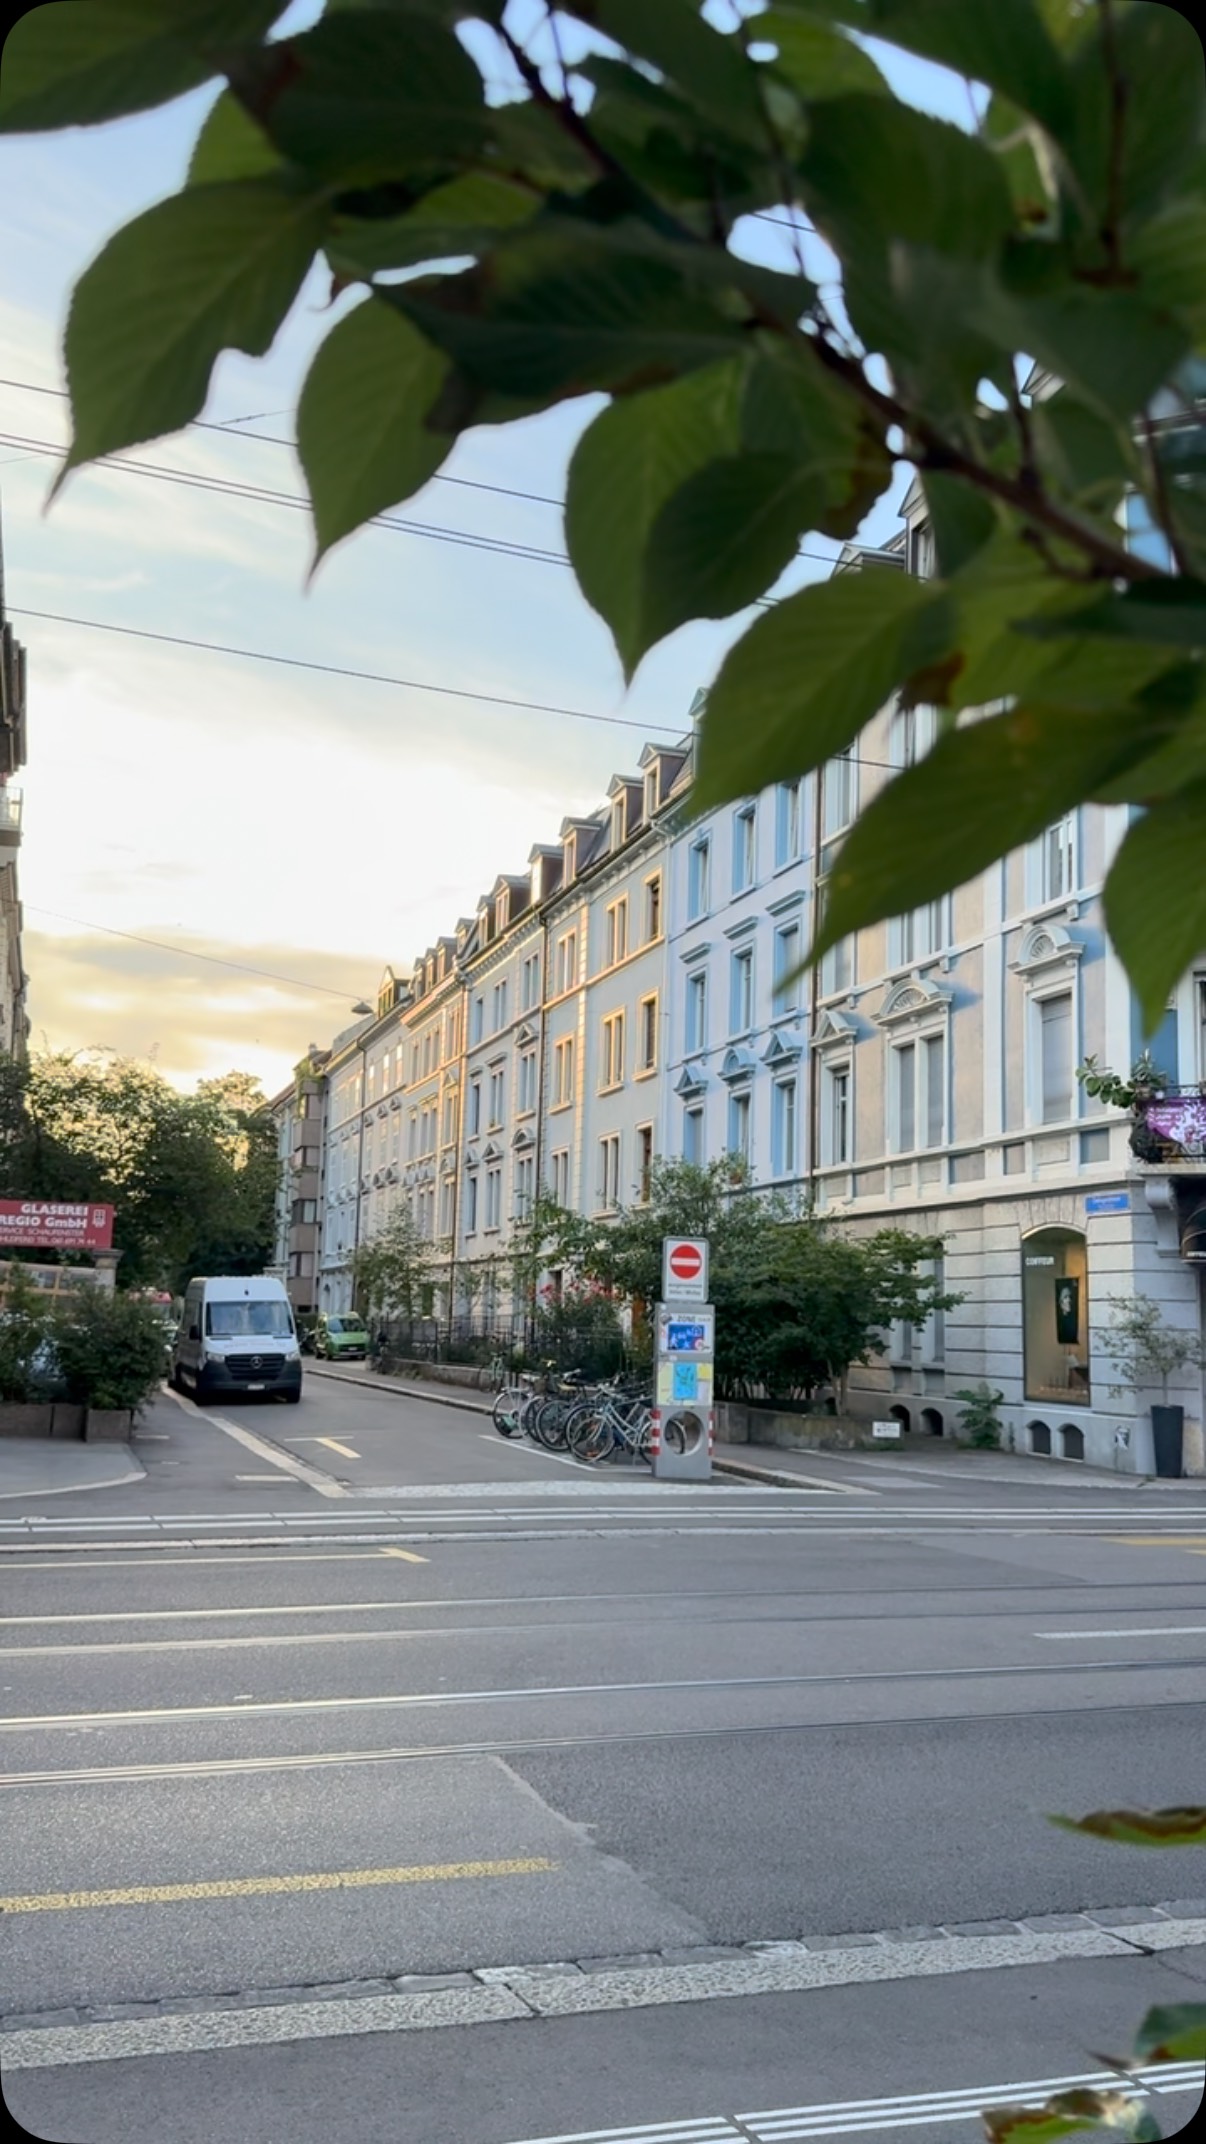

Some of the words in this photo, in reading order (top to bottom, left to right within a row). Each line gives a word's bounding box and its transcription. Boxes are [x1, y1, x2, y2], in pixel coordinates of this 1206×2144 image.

[21, 1203, 89, 1217] GLASEREI
[0, 1214, 41, 1227] REGIO
[44, 1217, 88, 1229] GmbH
